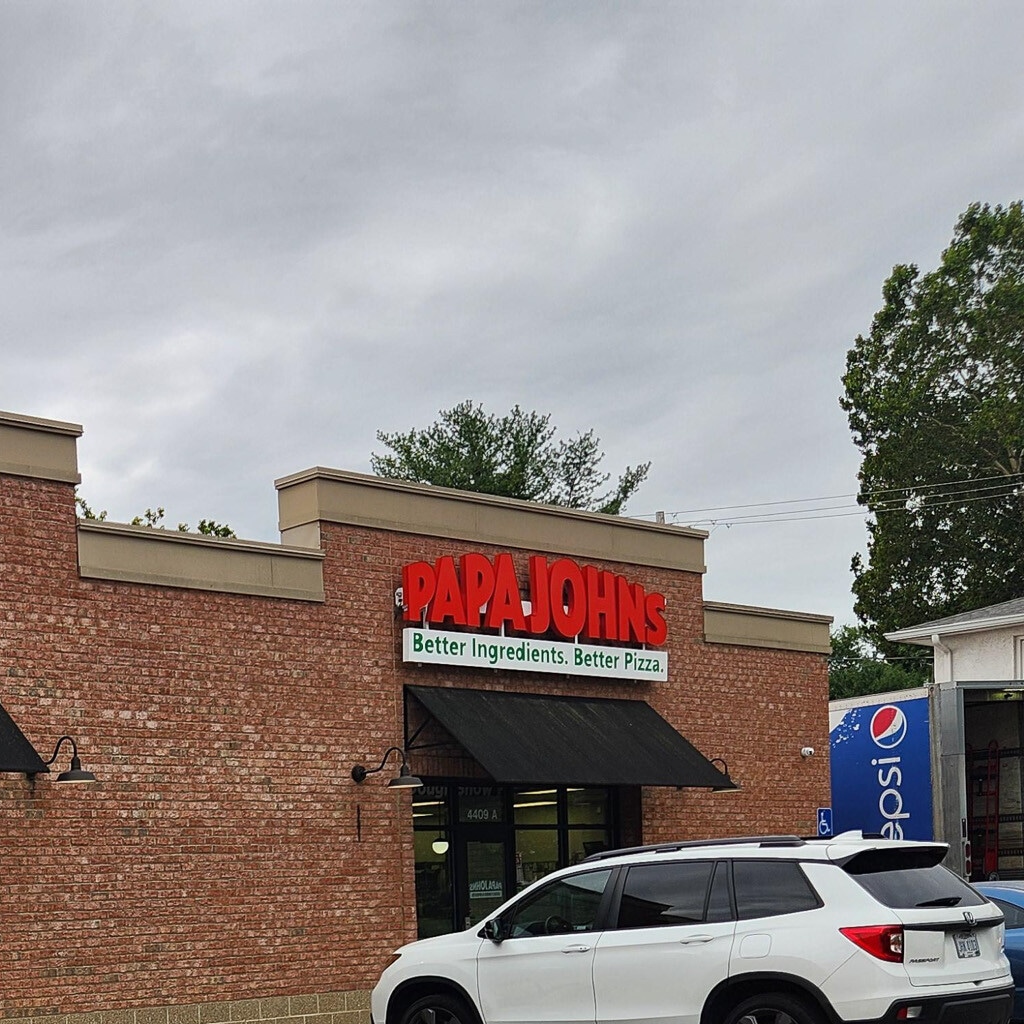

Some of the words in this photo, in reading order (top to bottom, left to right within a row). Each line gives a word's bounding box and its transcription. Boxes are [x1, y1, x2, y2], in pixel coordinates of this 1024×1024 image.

[413, 632, 466, 657] Better
[472, 637, 568, 664] Ingredients.
[574, 647, 620, 670] Better
[624, 652, 664, 673] Pizza.
[467, 809, 489, 820] 4409
[492, 809, 497, 820] A
[871, 757, 910, 840] epsi
